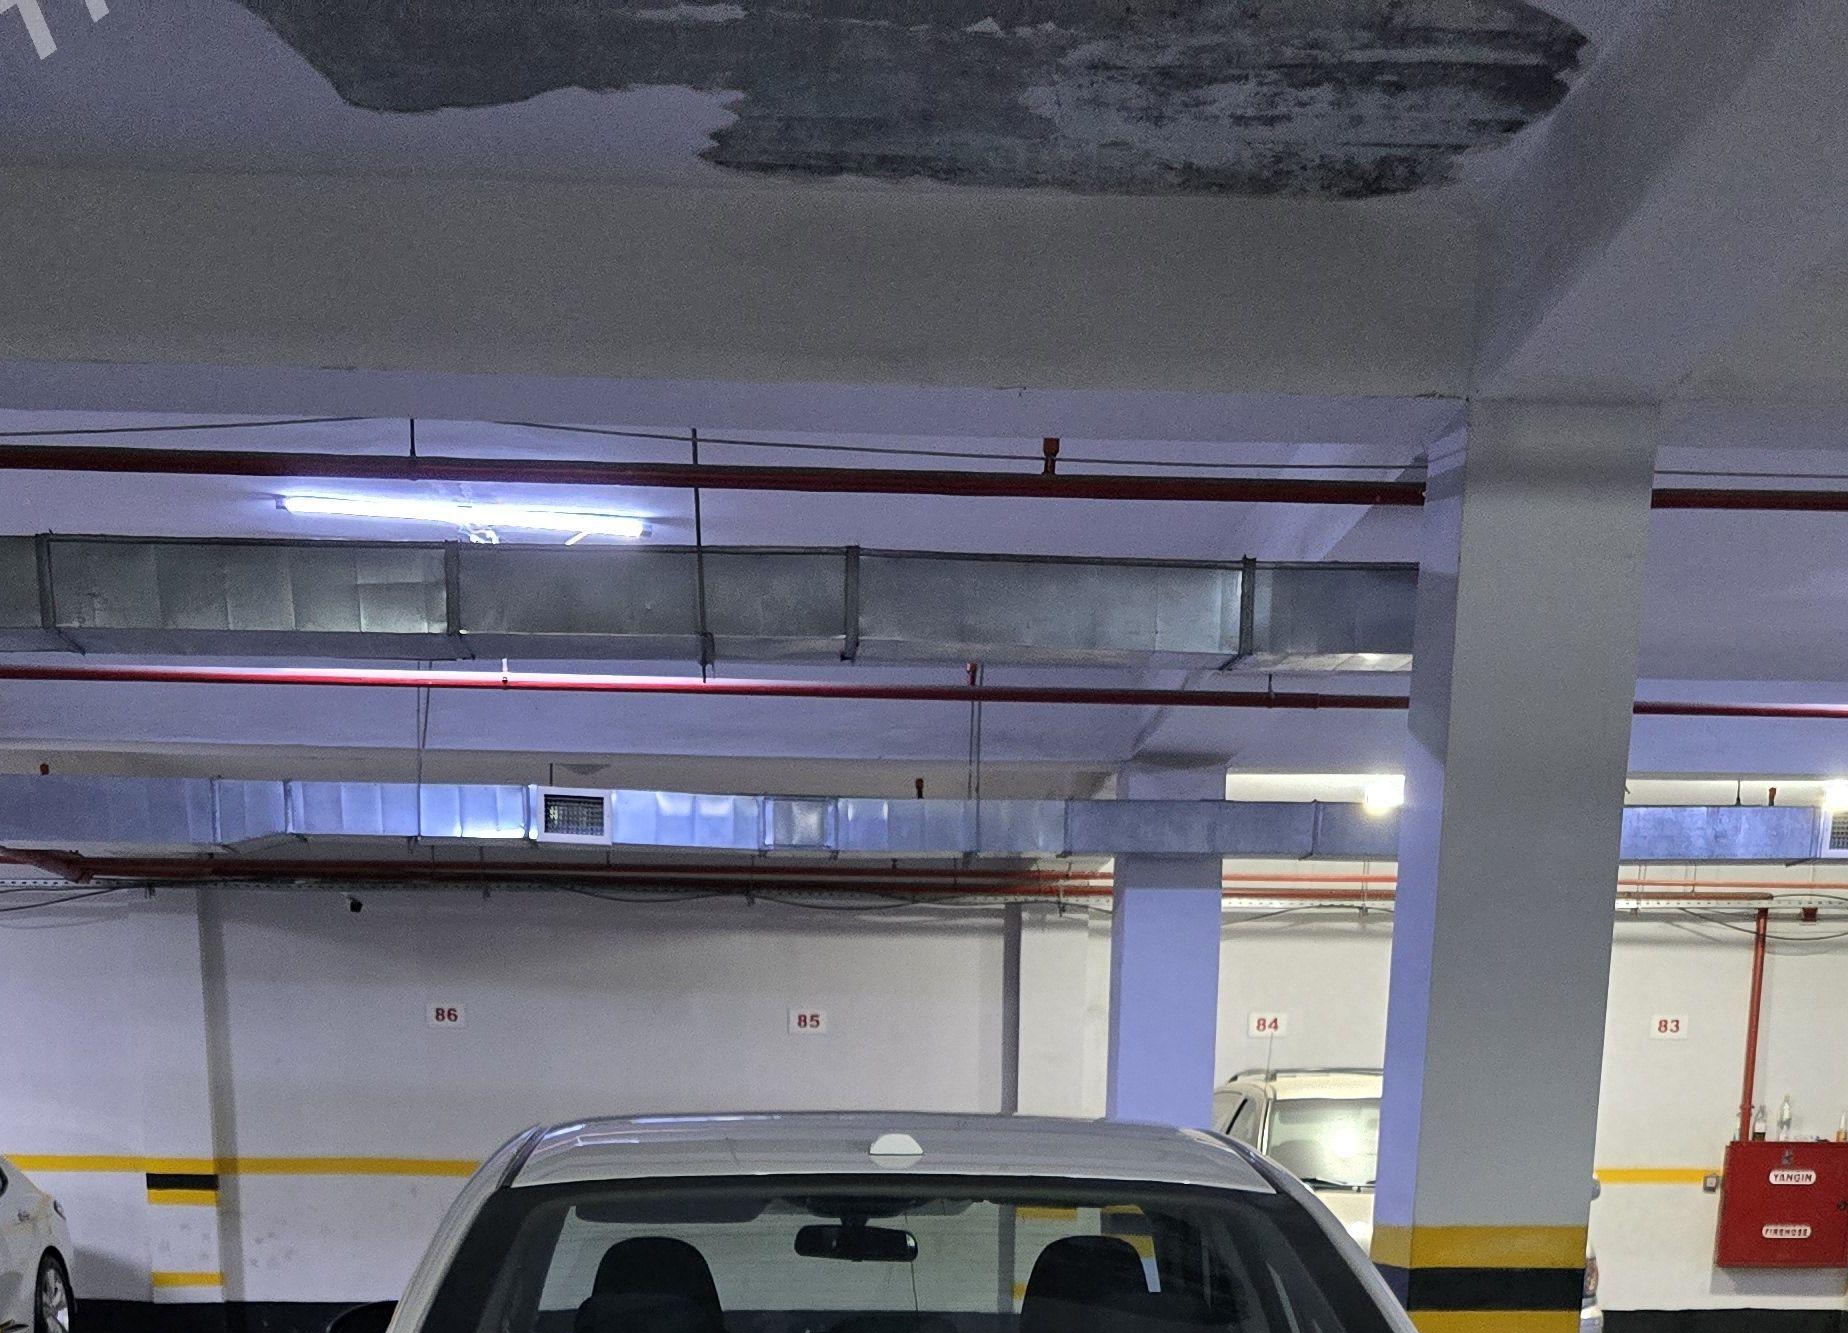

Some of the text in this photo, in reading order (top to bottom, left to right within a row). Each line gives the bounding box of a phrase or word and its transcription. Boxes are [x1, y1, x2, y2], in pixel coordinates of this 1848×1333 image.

[435, 1007, 459, 1022] 86
[797, 1014, 820, 1028] 85
[1256, 1017, 1279, 1032] 84
[1657, 1019, 1680, 1033] 83
[1773, 1173, 1813, 1183] YANGIN
